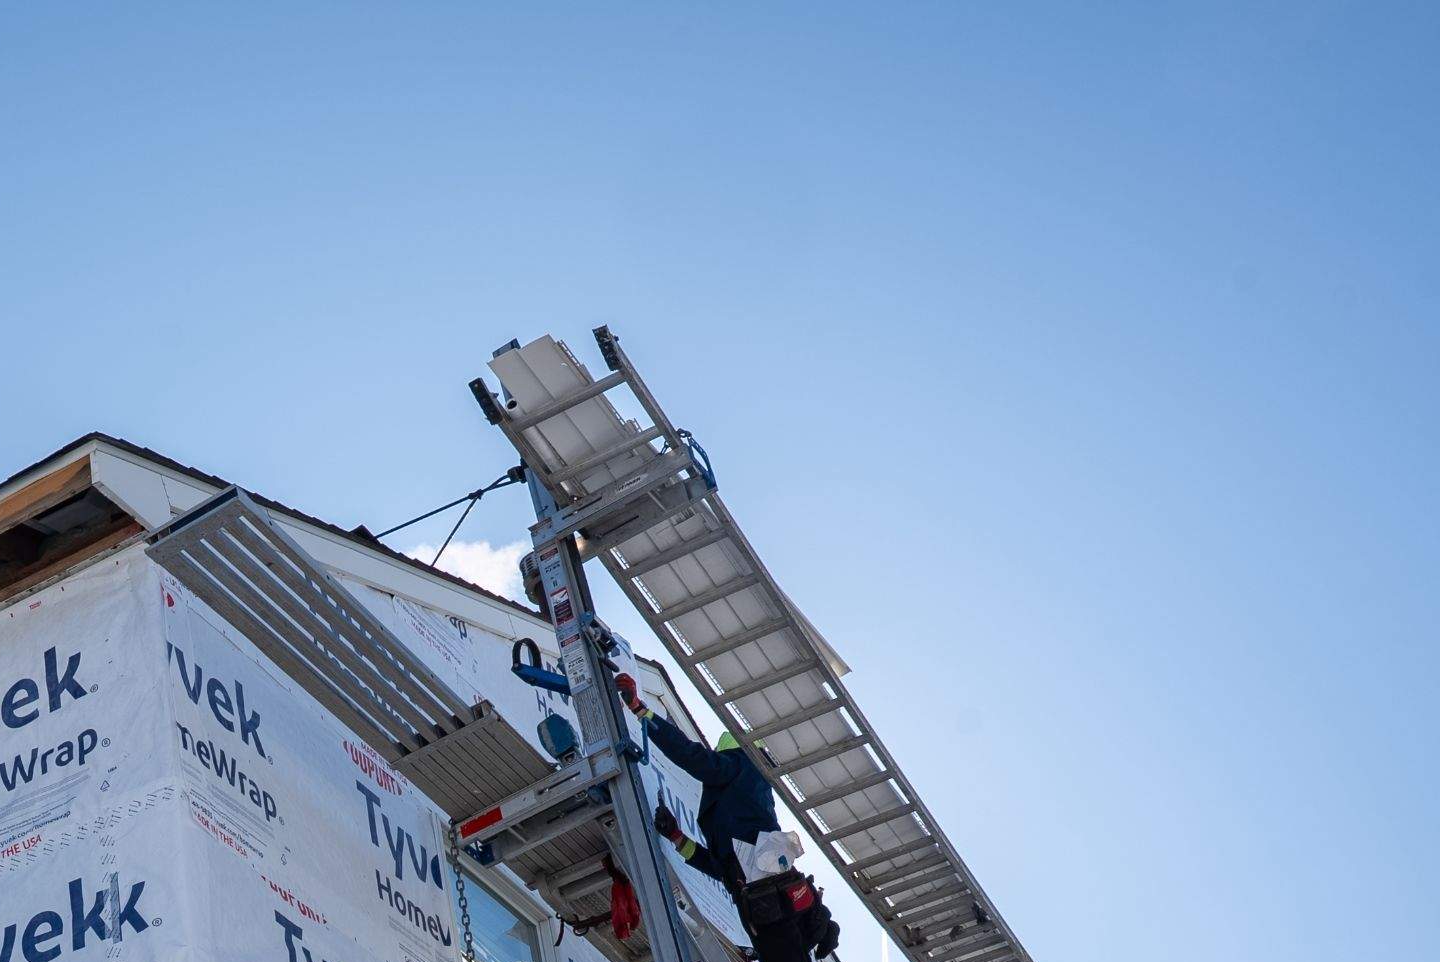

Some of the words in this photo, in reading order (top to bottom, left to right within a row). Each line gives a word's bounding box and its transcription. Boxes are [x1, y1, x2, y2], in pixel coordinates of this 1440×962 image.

[445, 615, 467, 640] ap
[166, 641, 267, 759] vek
[343, 741, 402, 795] DUPONT
[1, 844, 21, 858] THE
[23, 835, 42, 849] USA
[220, 832, 234, 847] THE
